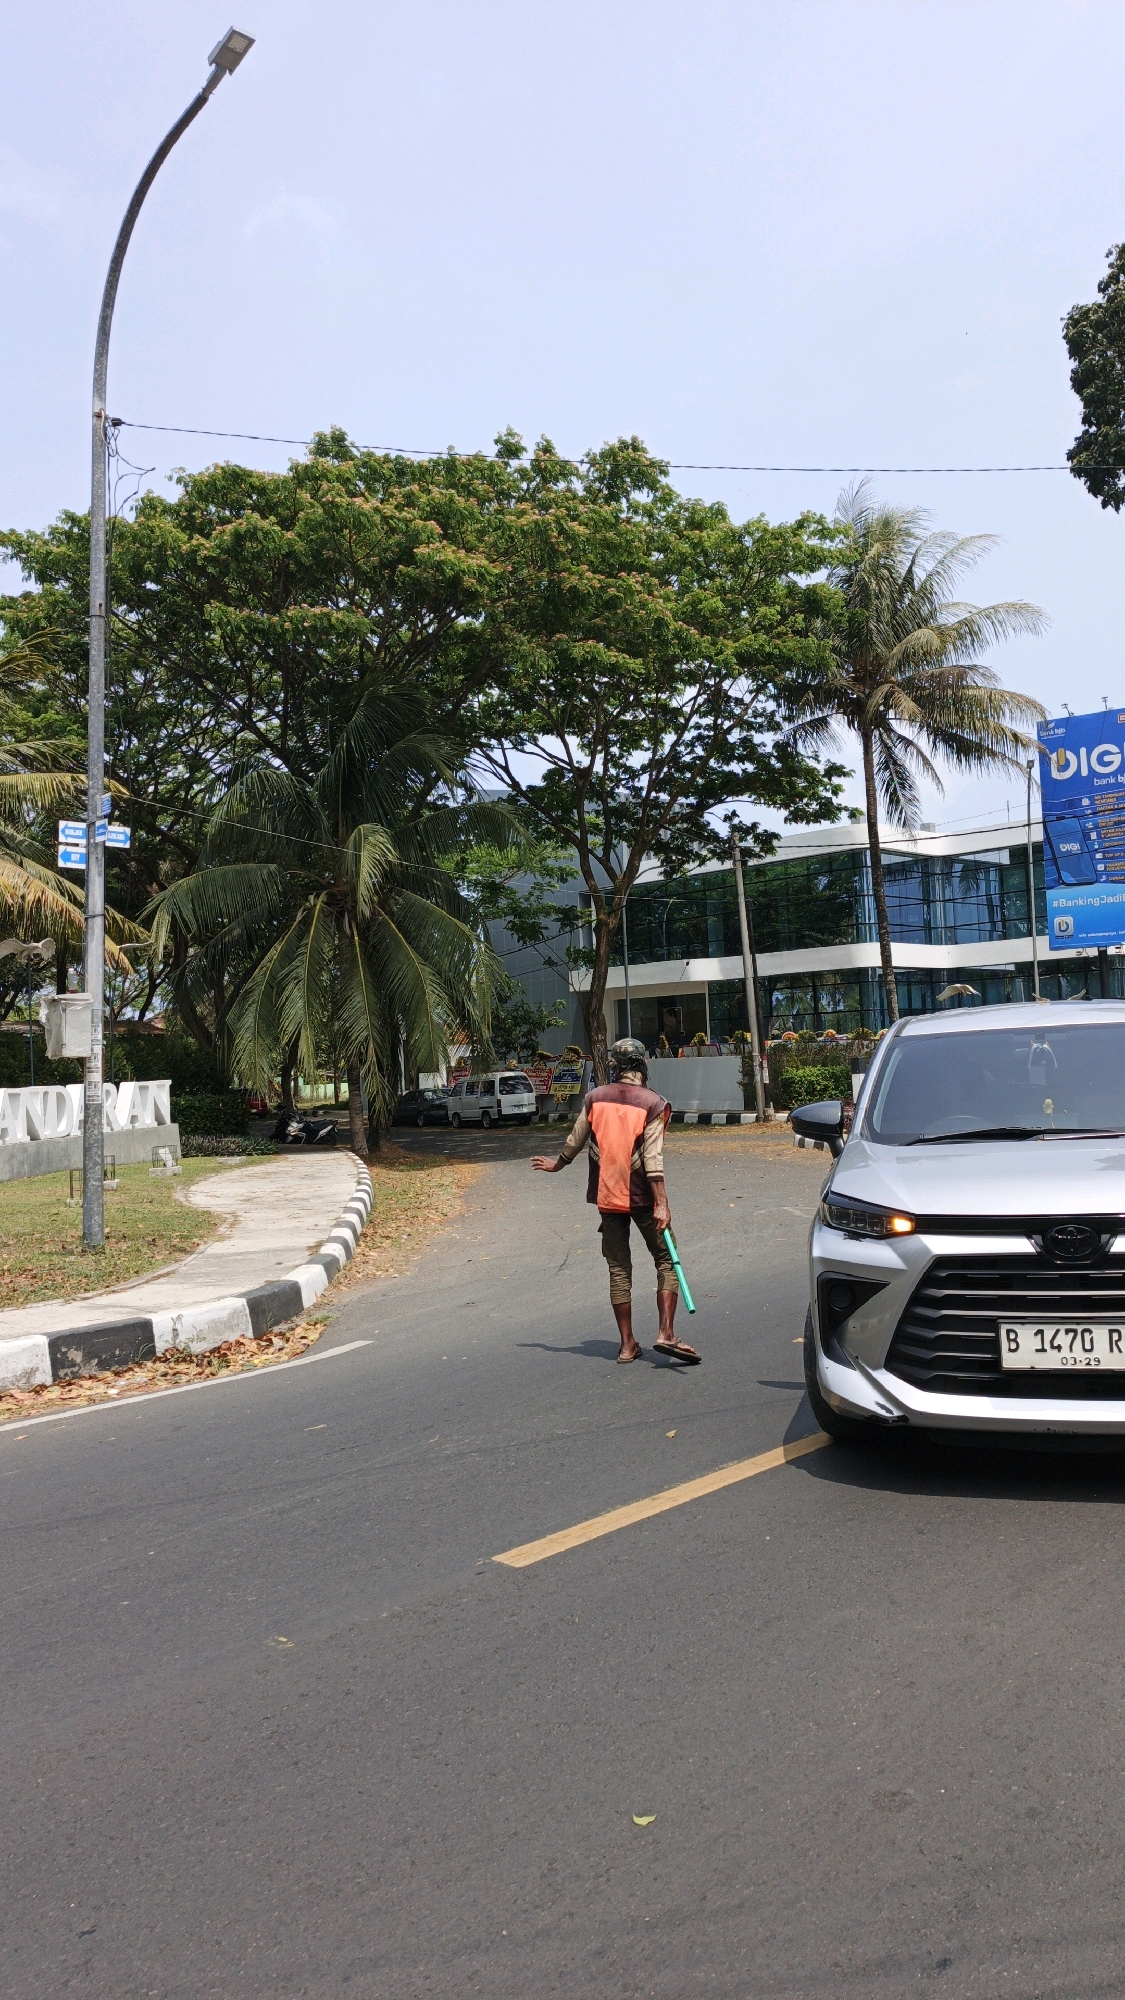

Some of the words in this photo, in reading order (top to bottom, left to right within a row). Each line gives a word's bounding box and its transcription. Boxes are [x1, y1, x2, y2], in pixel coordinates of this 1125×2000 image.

[1051, 742, 1125, 780] DIG
[1094, 775, 1116, 785] bank
[1060, 843, 1080, 851] DIGI
[1006, 1328, 1020, 1353] B
[1034, 1328, 1094, 1353] 1470
[1108, 1328, 1123, 1353] R
